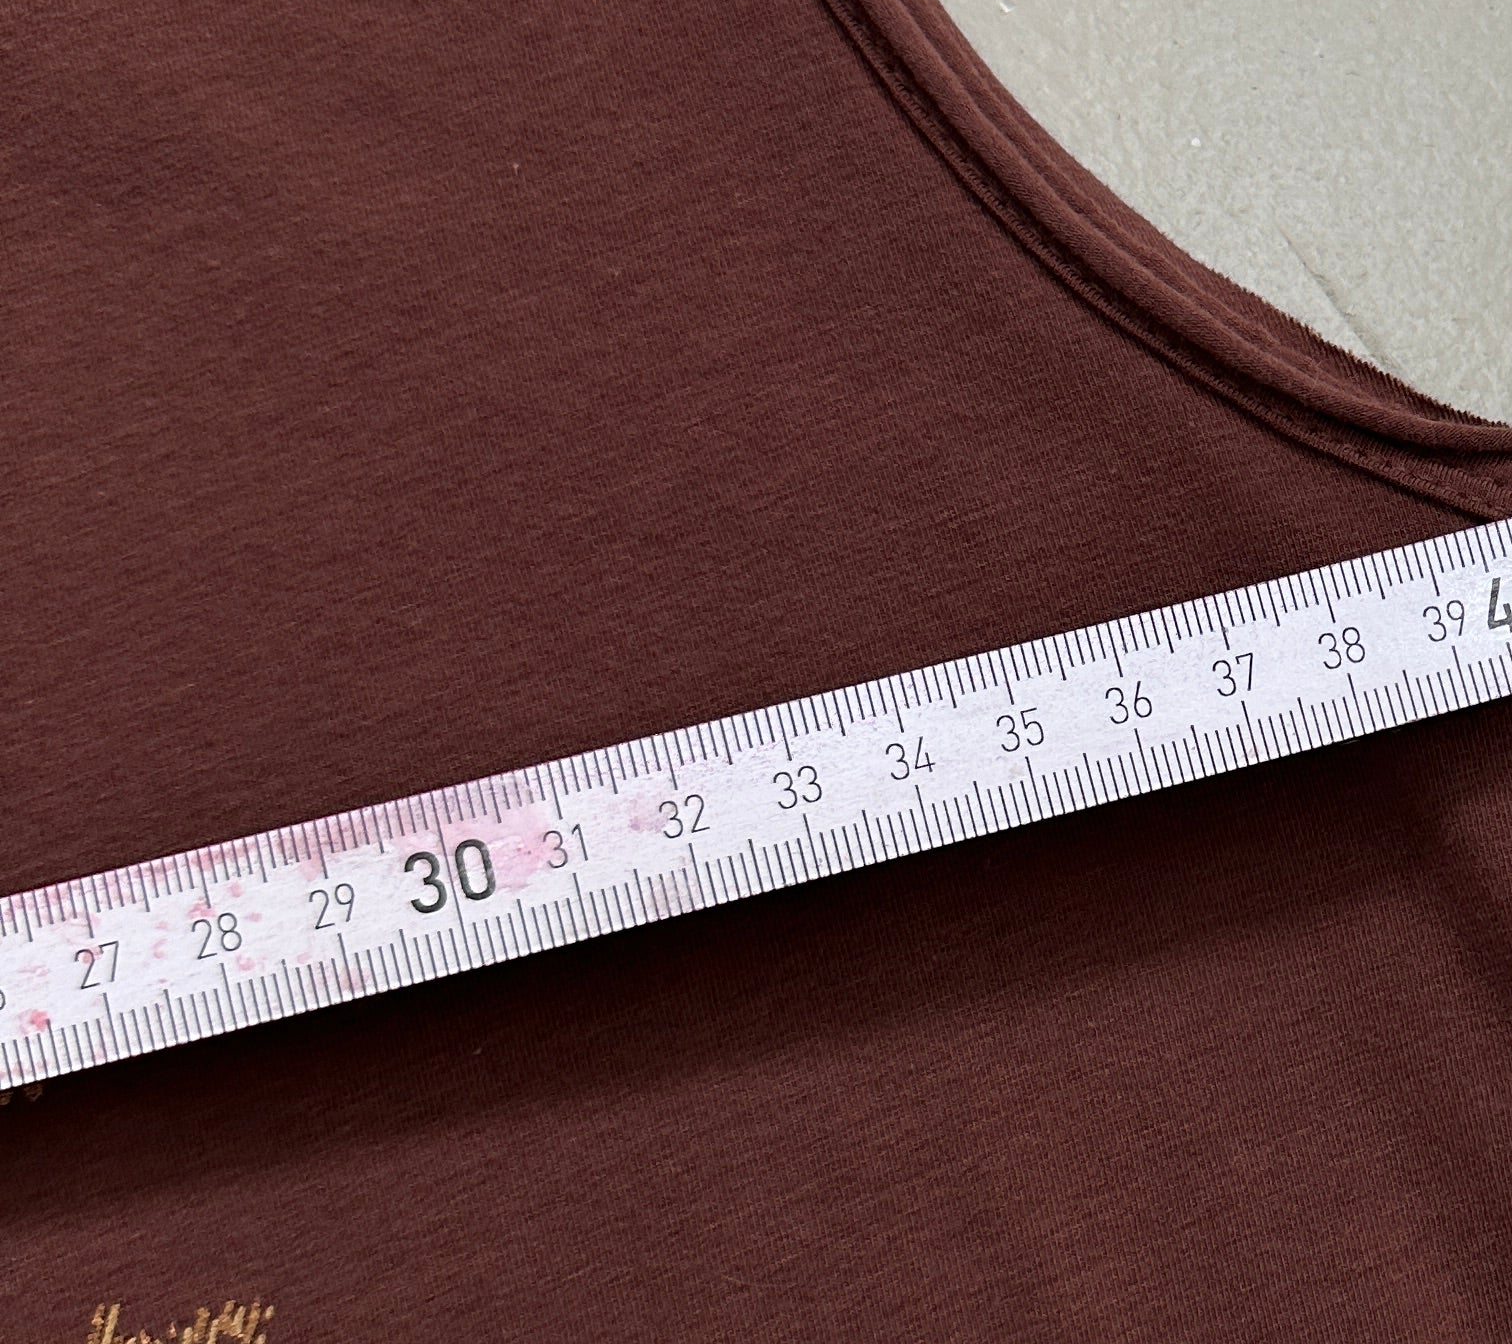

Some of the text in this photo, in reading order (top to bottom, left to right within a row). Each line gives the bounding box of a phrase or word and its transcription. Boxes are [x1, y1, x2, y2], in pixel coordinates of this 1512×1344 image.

[74, 941, 120, 989] 27
[191, 913, 242, 959] 28
[308, 883, 355, 930] 29
[404, 838, 497, 914] 30
[542, 823, 589, 869] 31
[658, 794, 710, 839] 32
[772, 765, 823, 809] 33
[885, 736, 936, 780] 34
[996, 707, 1045, 753] 35
[1104, 681, 1153, 725] 36
[1211, 653, 1255, 697] 37
[1318, 627, 1366, 669] 38
[1422, 600, 1466, 642] 39
